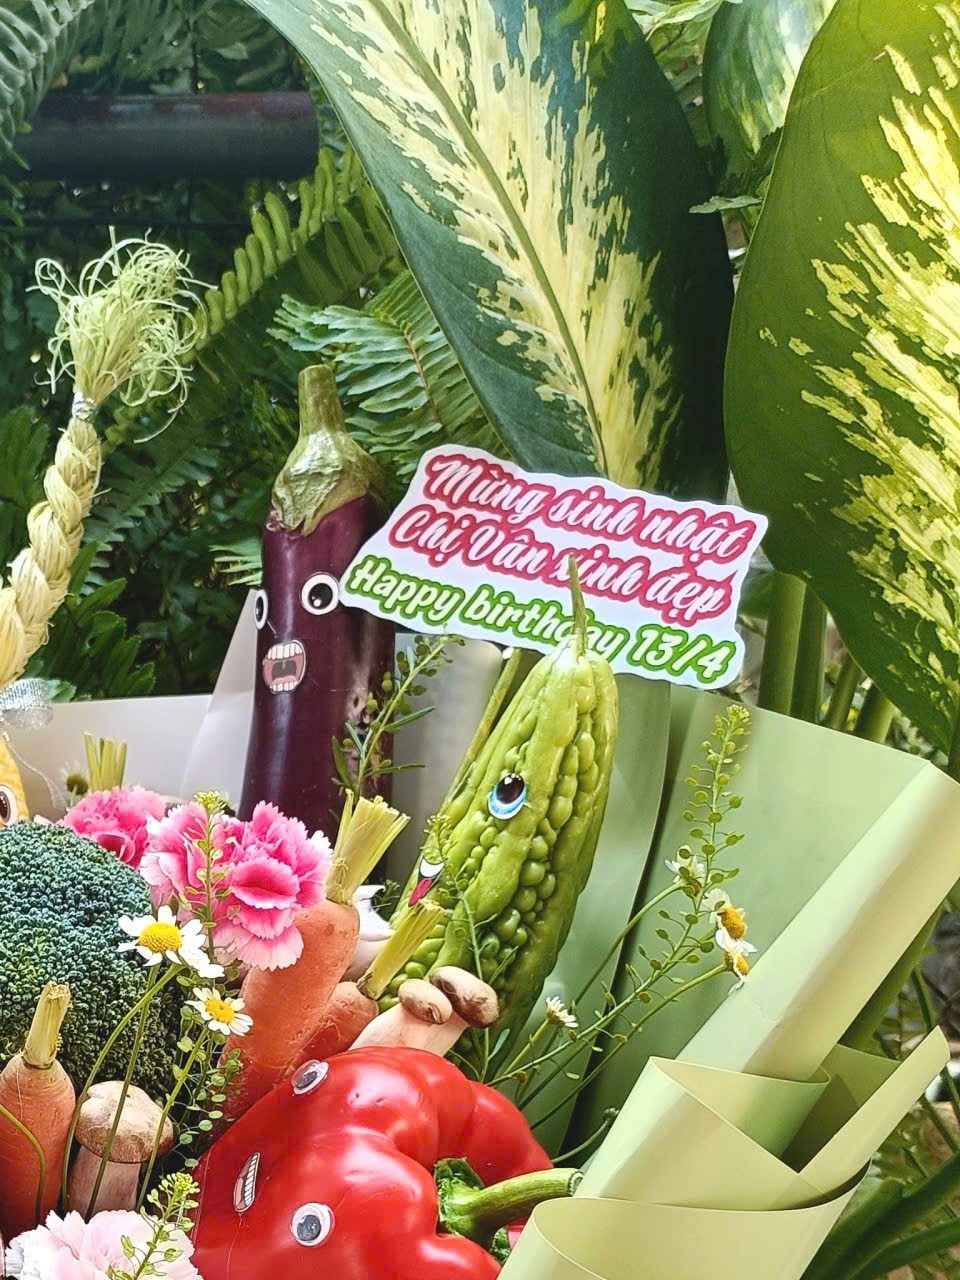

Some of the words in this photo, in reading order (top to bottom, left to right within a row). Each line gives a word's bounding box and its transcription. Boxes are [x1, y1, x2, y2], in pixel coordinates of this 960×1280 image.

[393, 508, 465, 563] Chị
[467, 522, 551, 575] Vân
[644, 569, 727, 622] đẹp
[547, 488, 642, 537] sinh
[639, 512, 751, 563] nhật
[349, 558, 463, 622] Happy
[630, 628, 732, 680] 13/4
